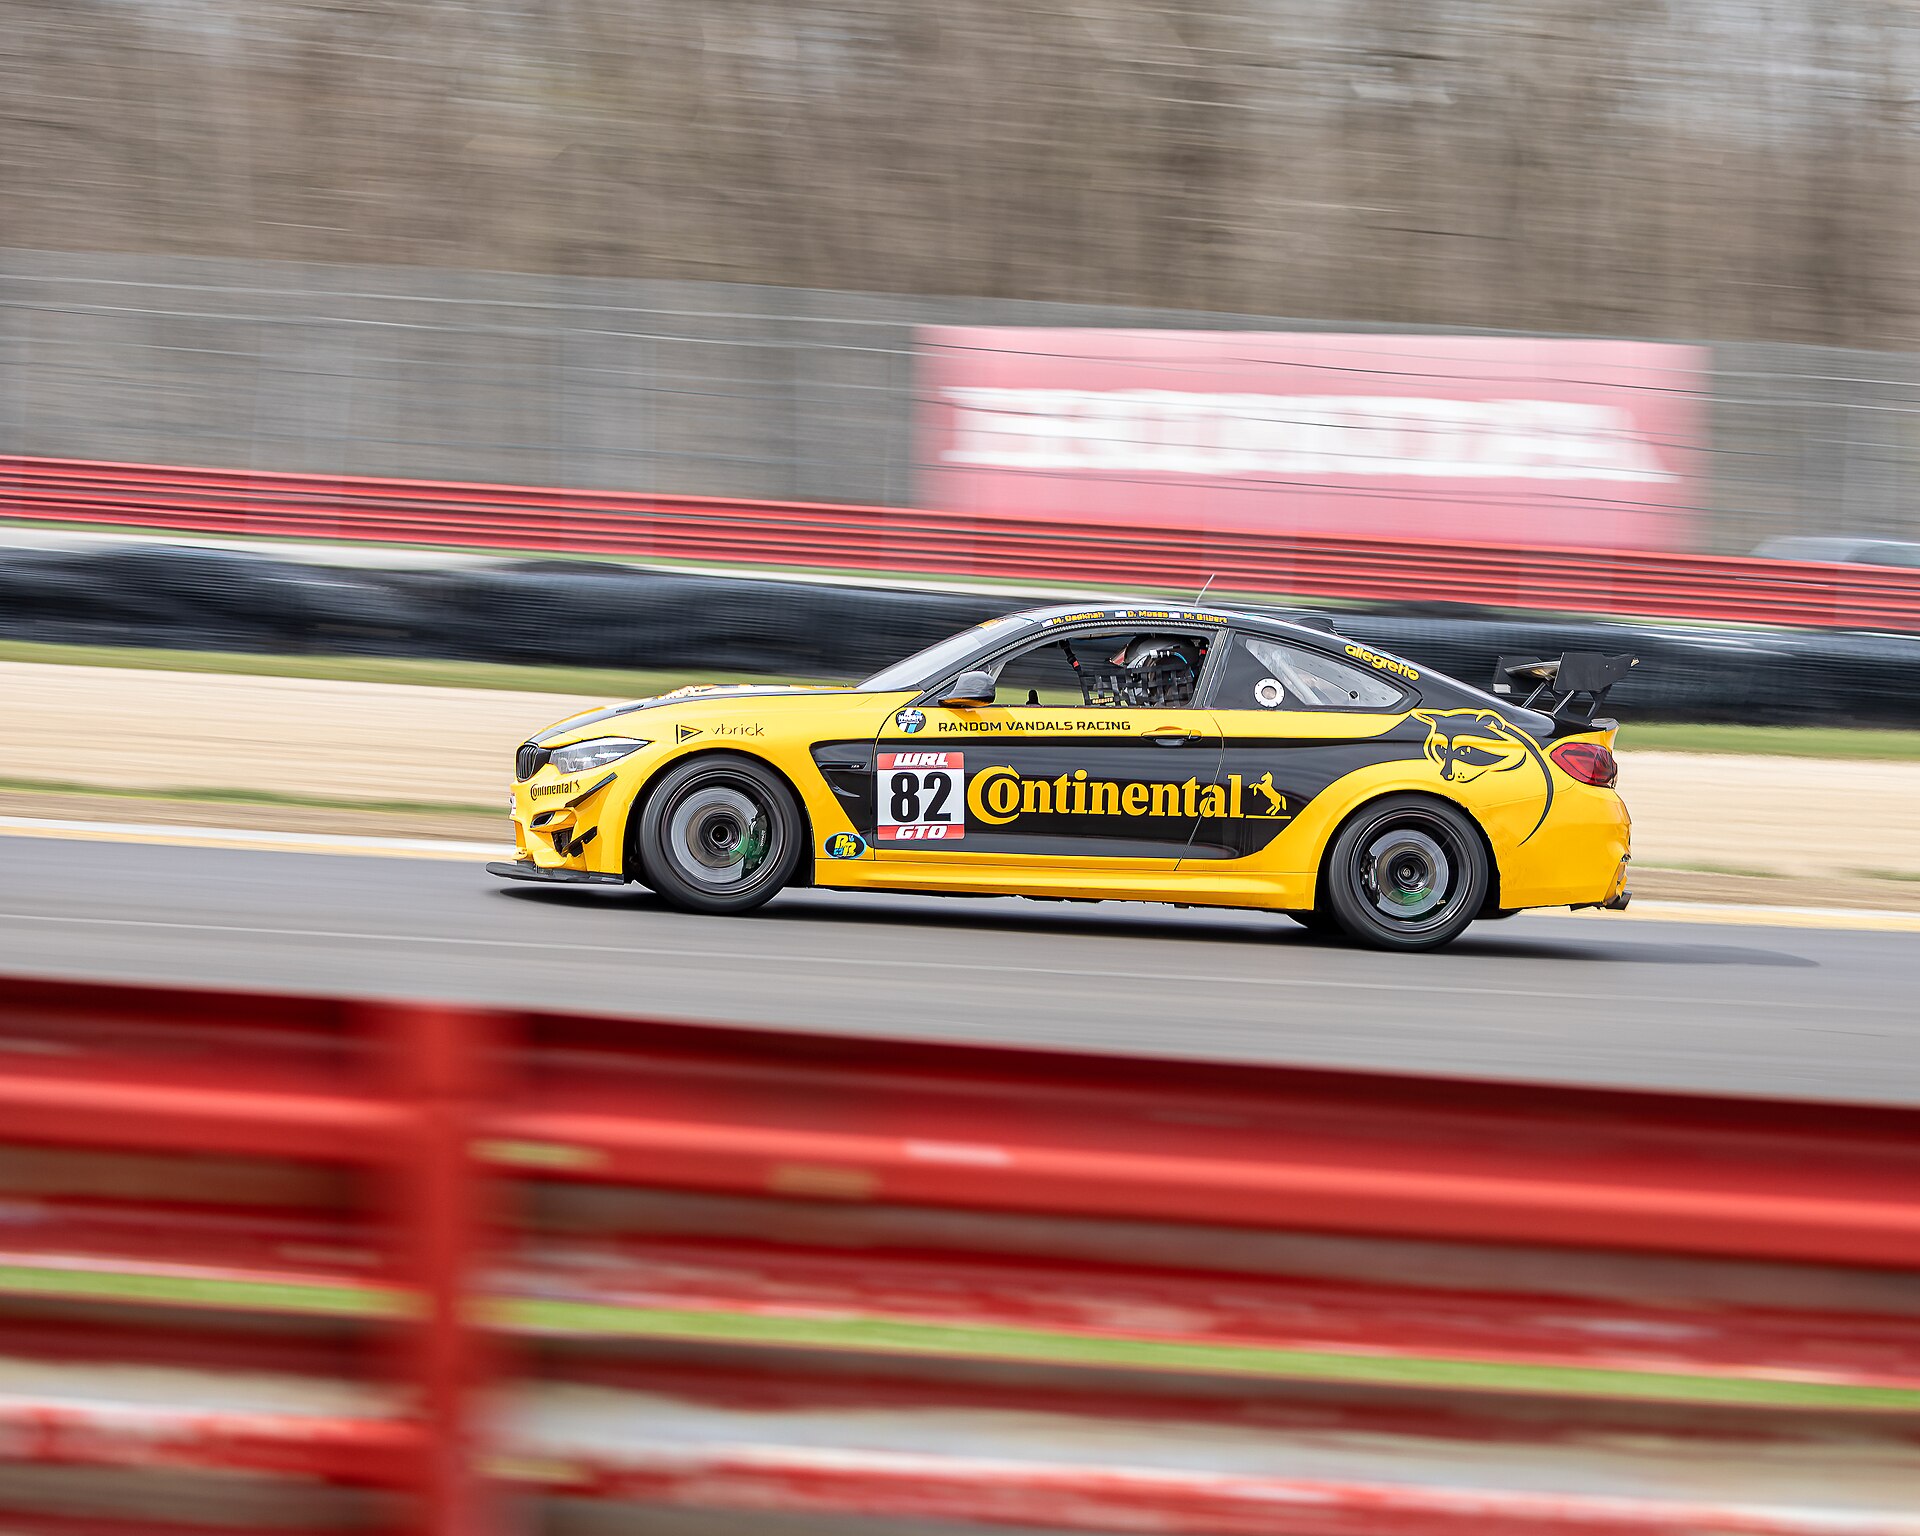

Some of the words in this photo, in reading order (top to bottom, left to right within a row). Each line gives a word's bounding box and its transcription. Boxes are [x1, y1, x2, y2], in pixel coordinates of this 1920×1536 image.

[1344, 644, 1420, 681] allegretto
[710, 722, 765, 737] vbrick
[938, 721, 1001, 732] RANDOM
[1005, 720, 1073, 731] VANDALS
[1076, 720, 1131, 731] RACING
[893, 752, 949, 767] WRL
[530, 780, 572, 802] Continental
[890, 771, 952, 823] 82
[967, 764, 1244, 825] Continental
[895, 825, 948, 840] GTO
